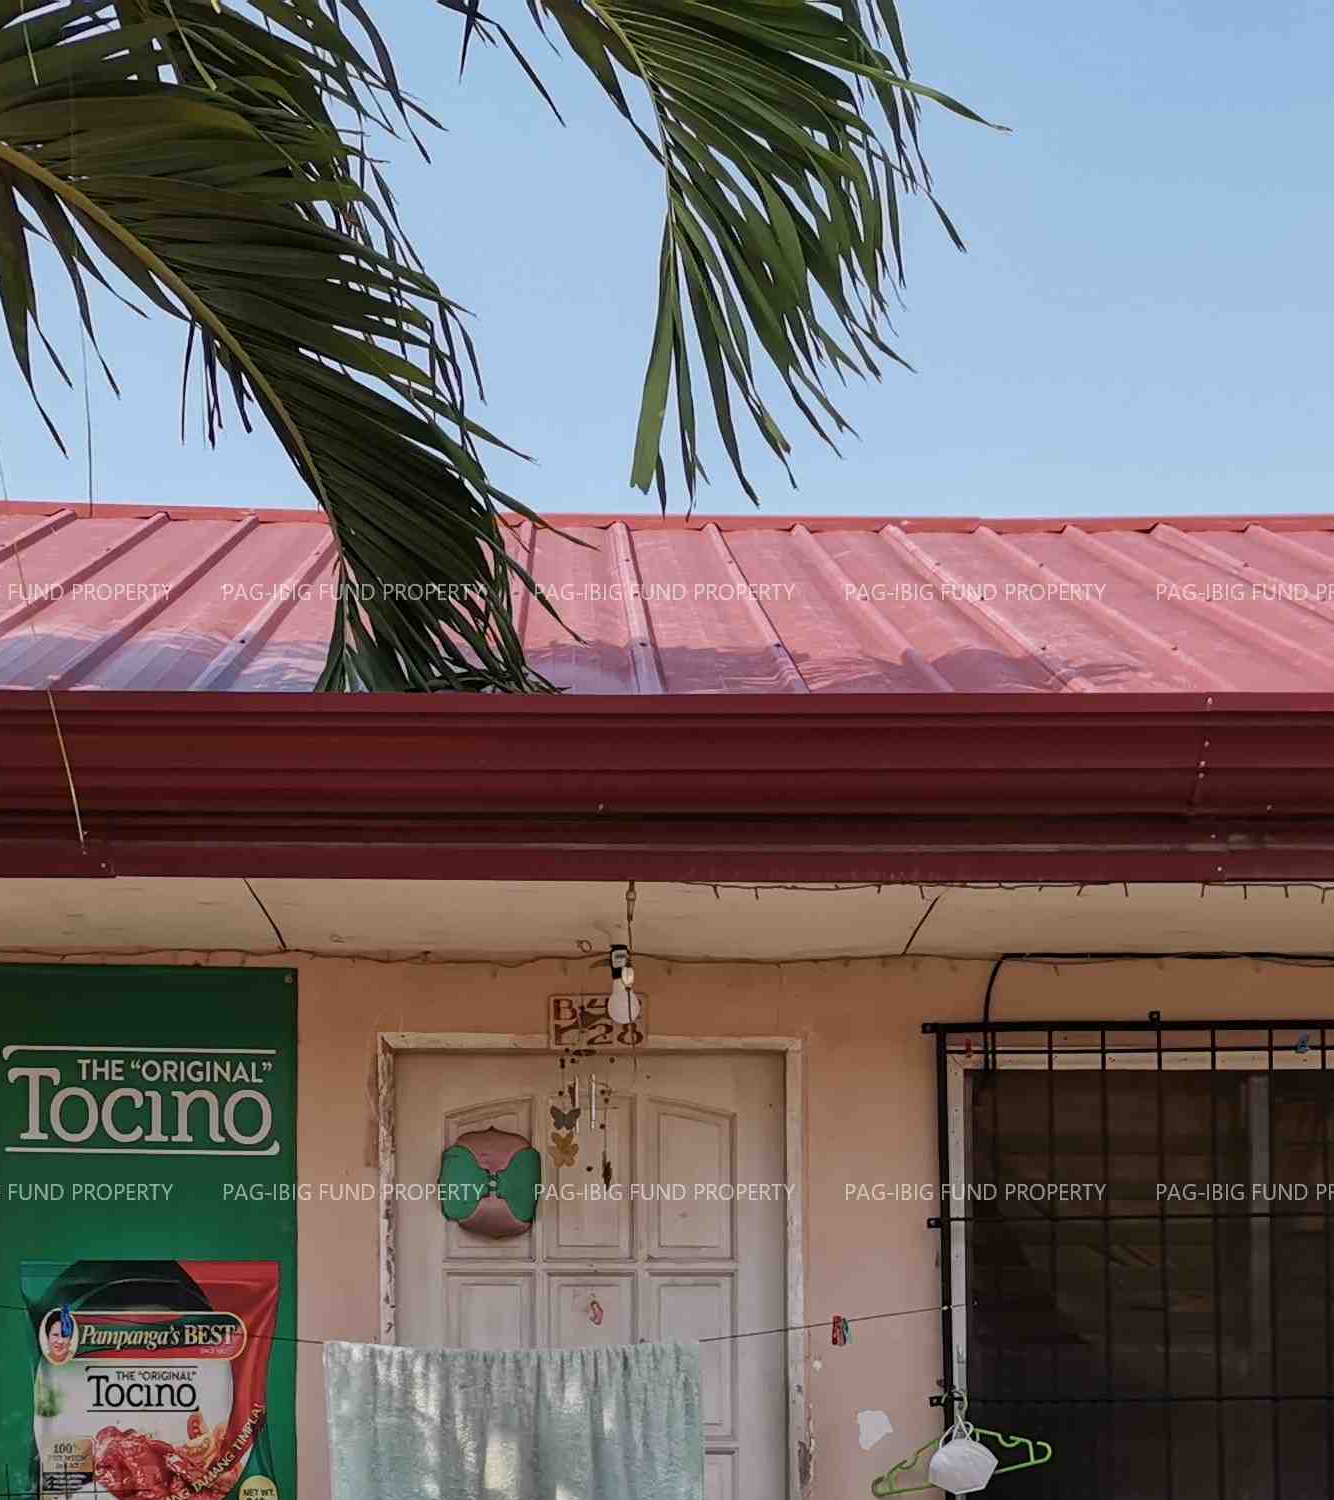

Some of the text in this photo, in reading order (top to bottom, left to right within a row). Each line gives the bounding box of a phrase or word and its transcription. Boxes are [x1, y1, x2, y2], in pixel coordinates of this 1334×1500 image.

[77, 1059, 273, 1083] THE "ORIGINAL"
[7, 1066, 274, 1145] Tocino
[80, 1324, 237, 1351] Pampanga's BEST
[115, 1370, 197, 1382] THE "ORIGINAL"
[87, 1375, 197, 1409] Tocino
[192, 1452, 235, 1494] TAMANG
